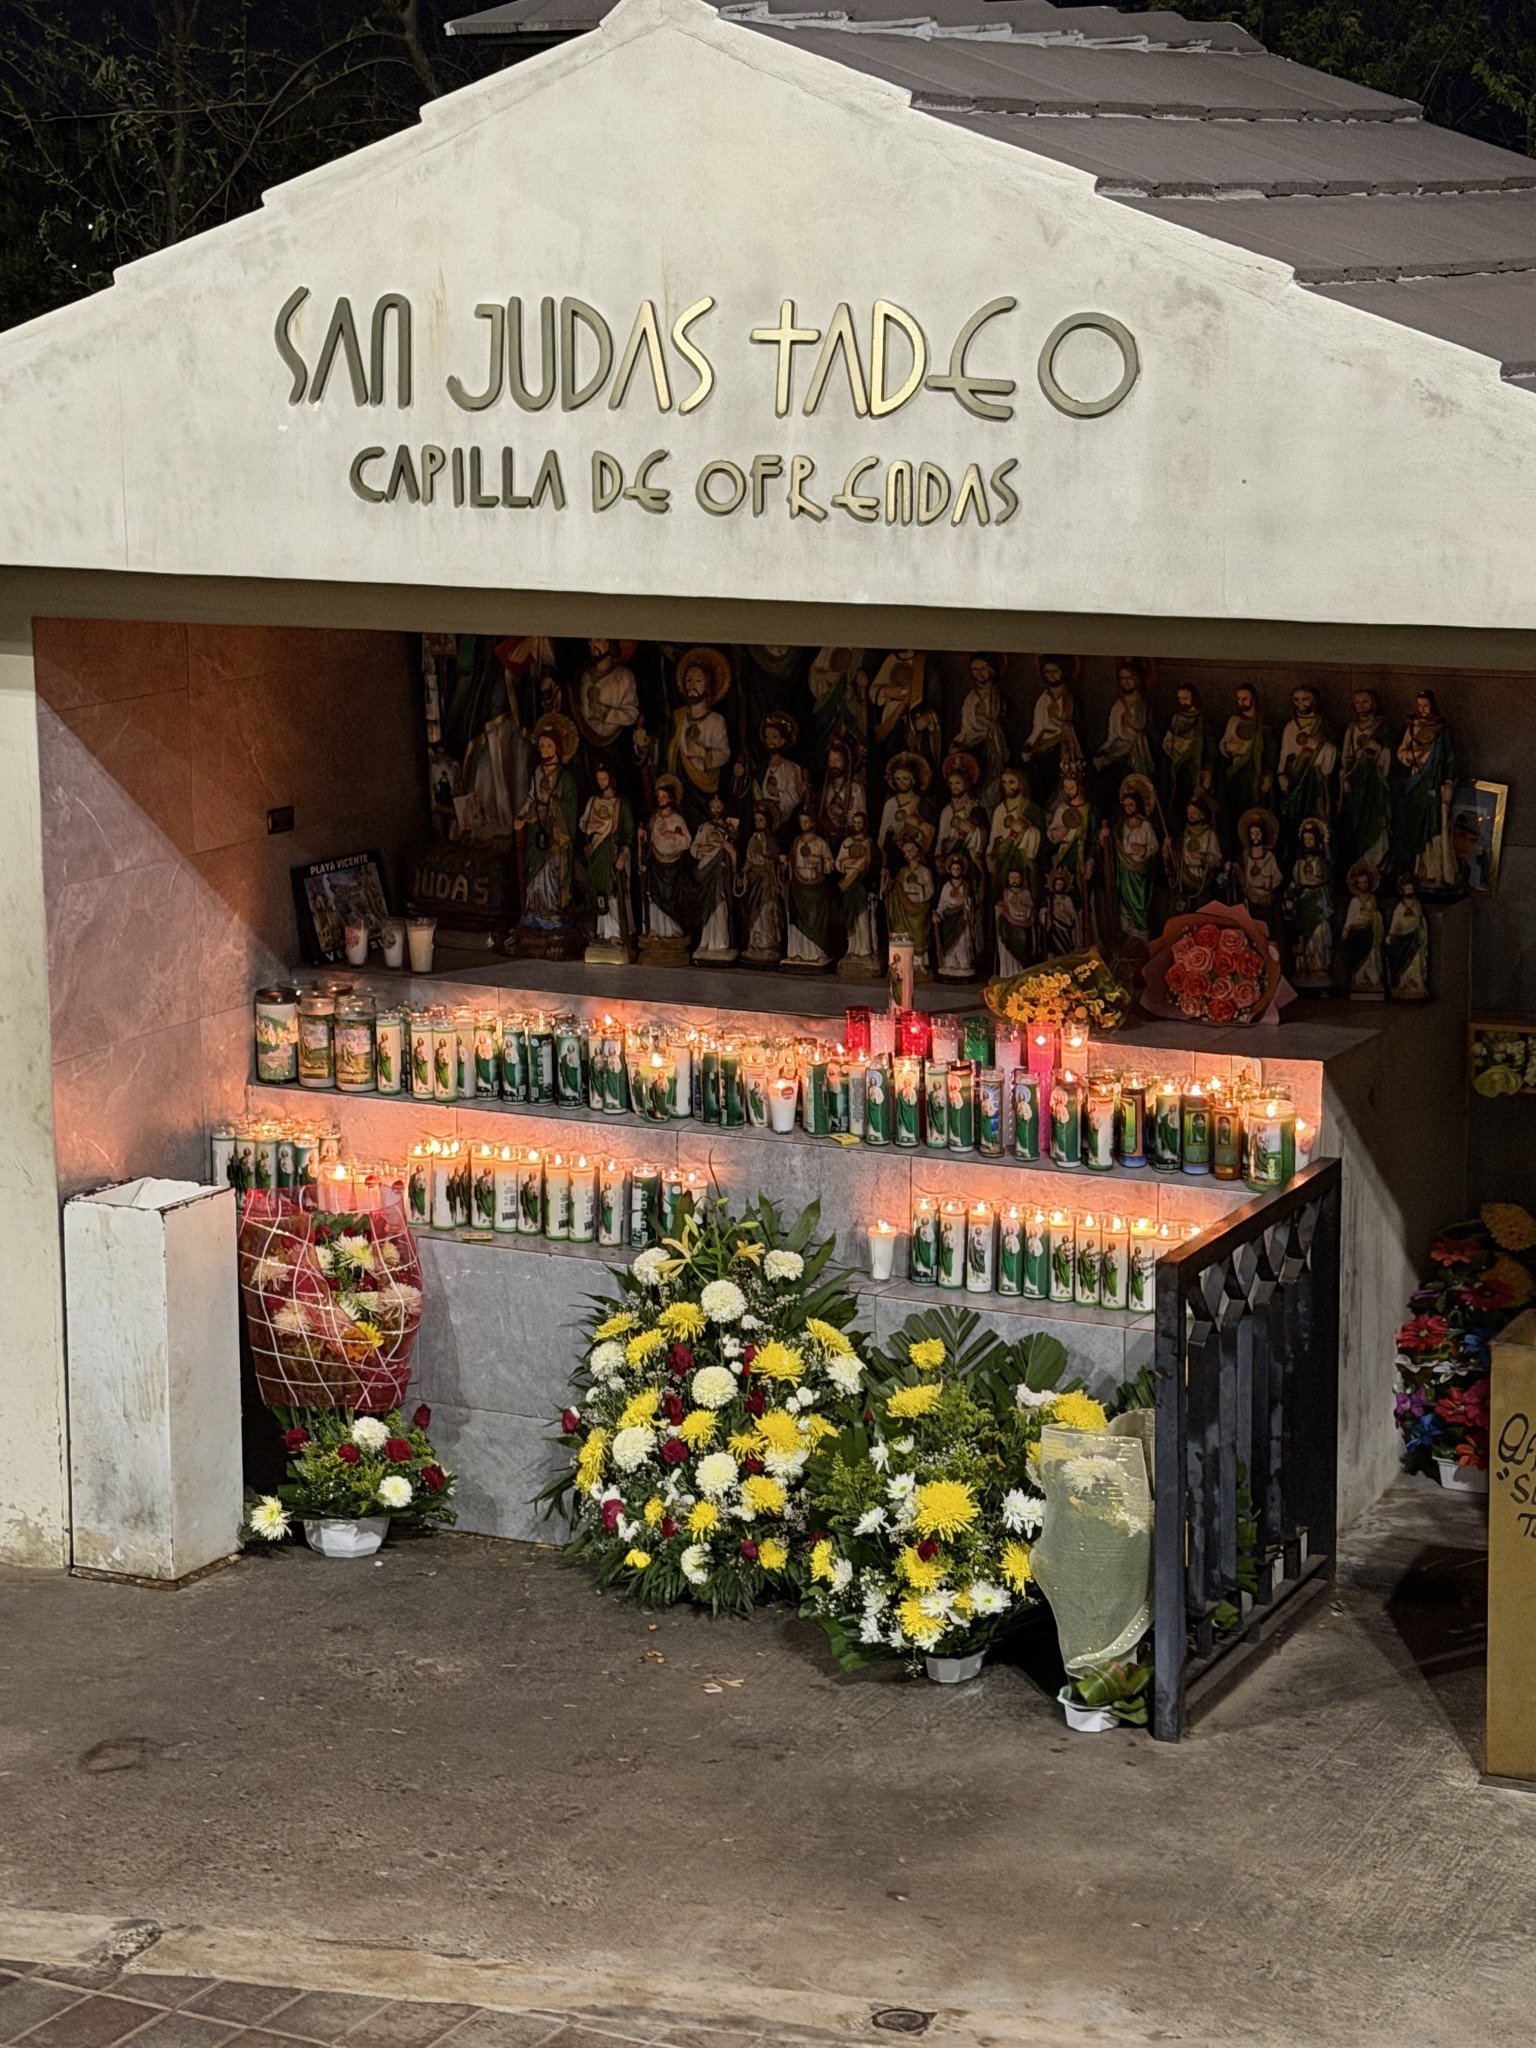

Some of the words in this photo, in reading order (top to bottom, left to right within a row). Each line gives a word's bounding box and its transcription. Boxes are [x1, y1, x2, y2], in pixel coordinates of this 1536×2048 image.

[274, 286, 411, 407] SAN
[447, 295, 716, 415] JUDAS
[750, 297, 1141, 420] TADEO
[350, 444, 567, 511] CAPILLA
[592, 450, 671, 514] DE
[695, 454, 1022, 527] OFRENDAS
[310, 860, 336, 876] PLAYA
[336, 853, 369, 869] VICENTE
